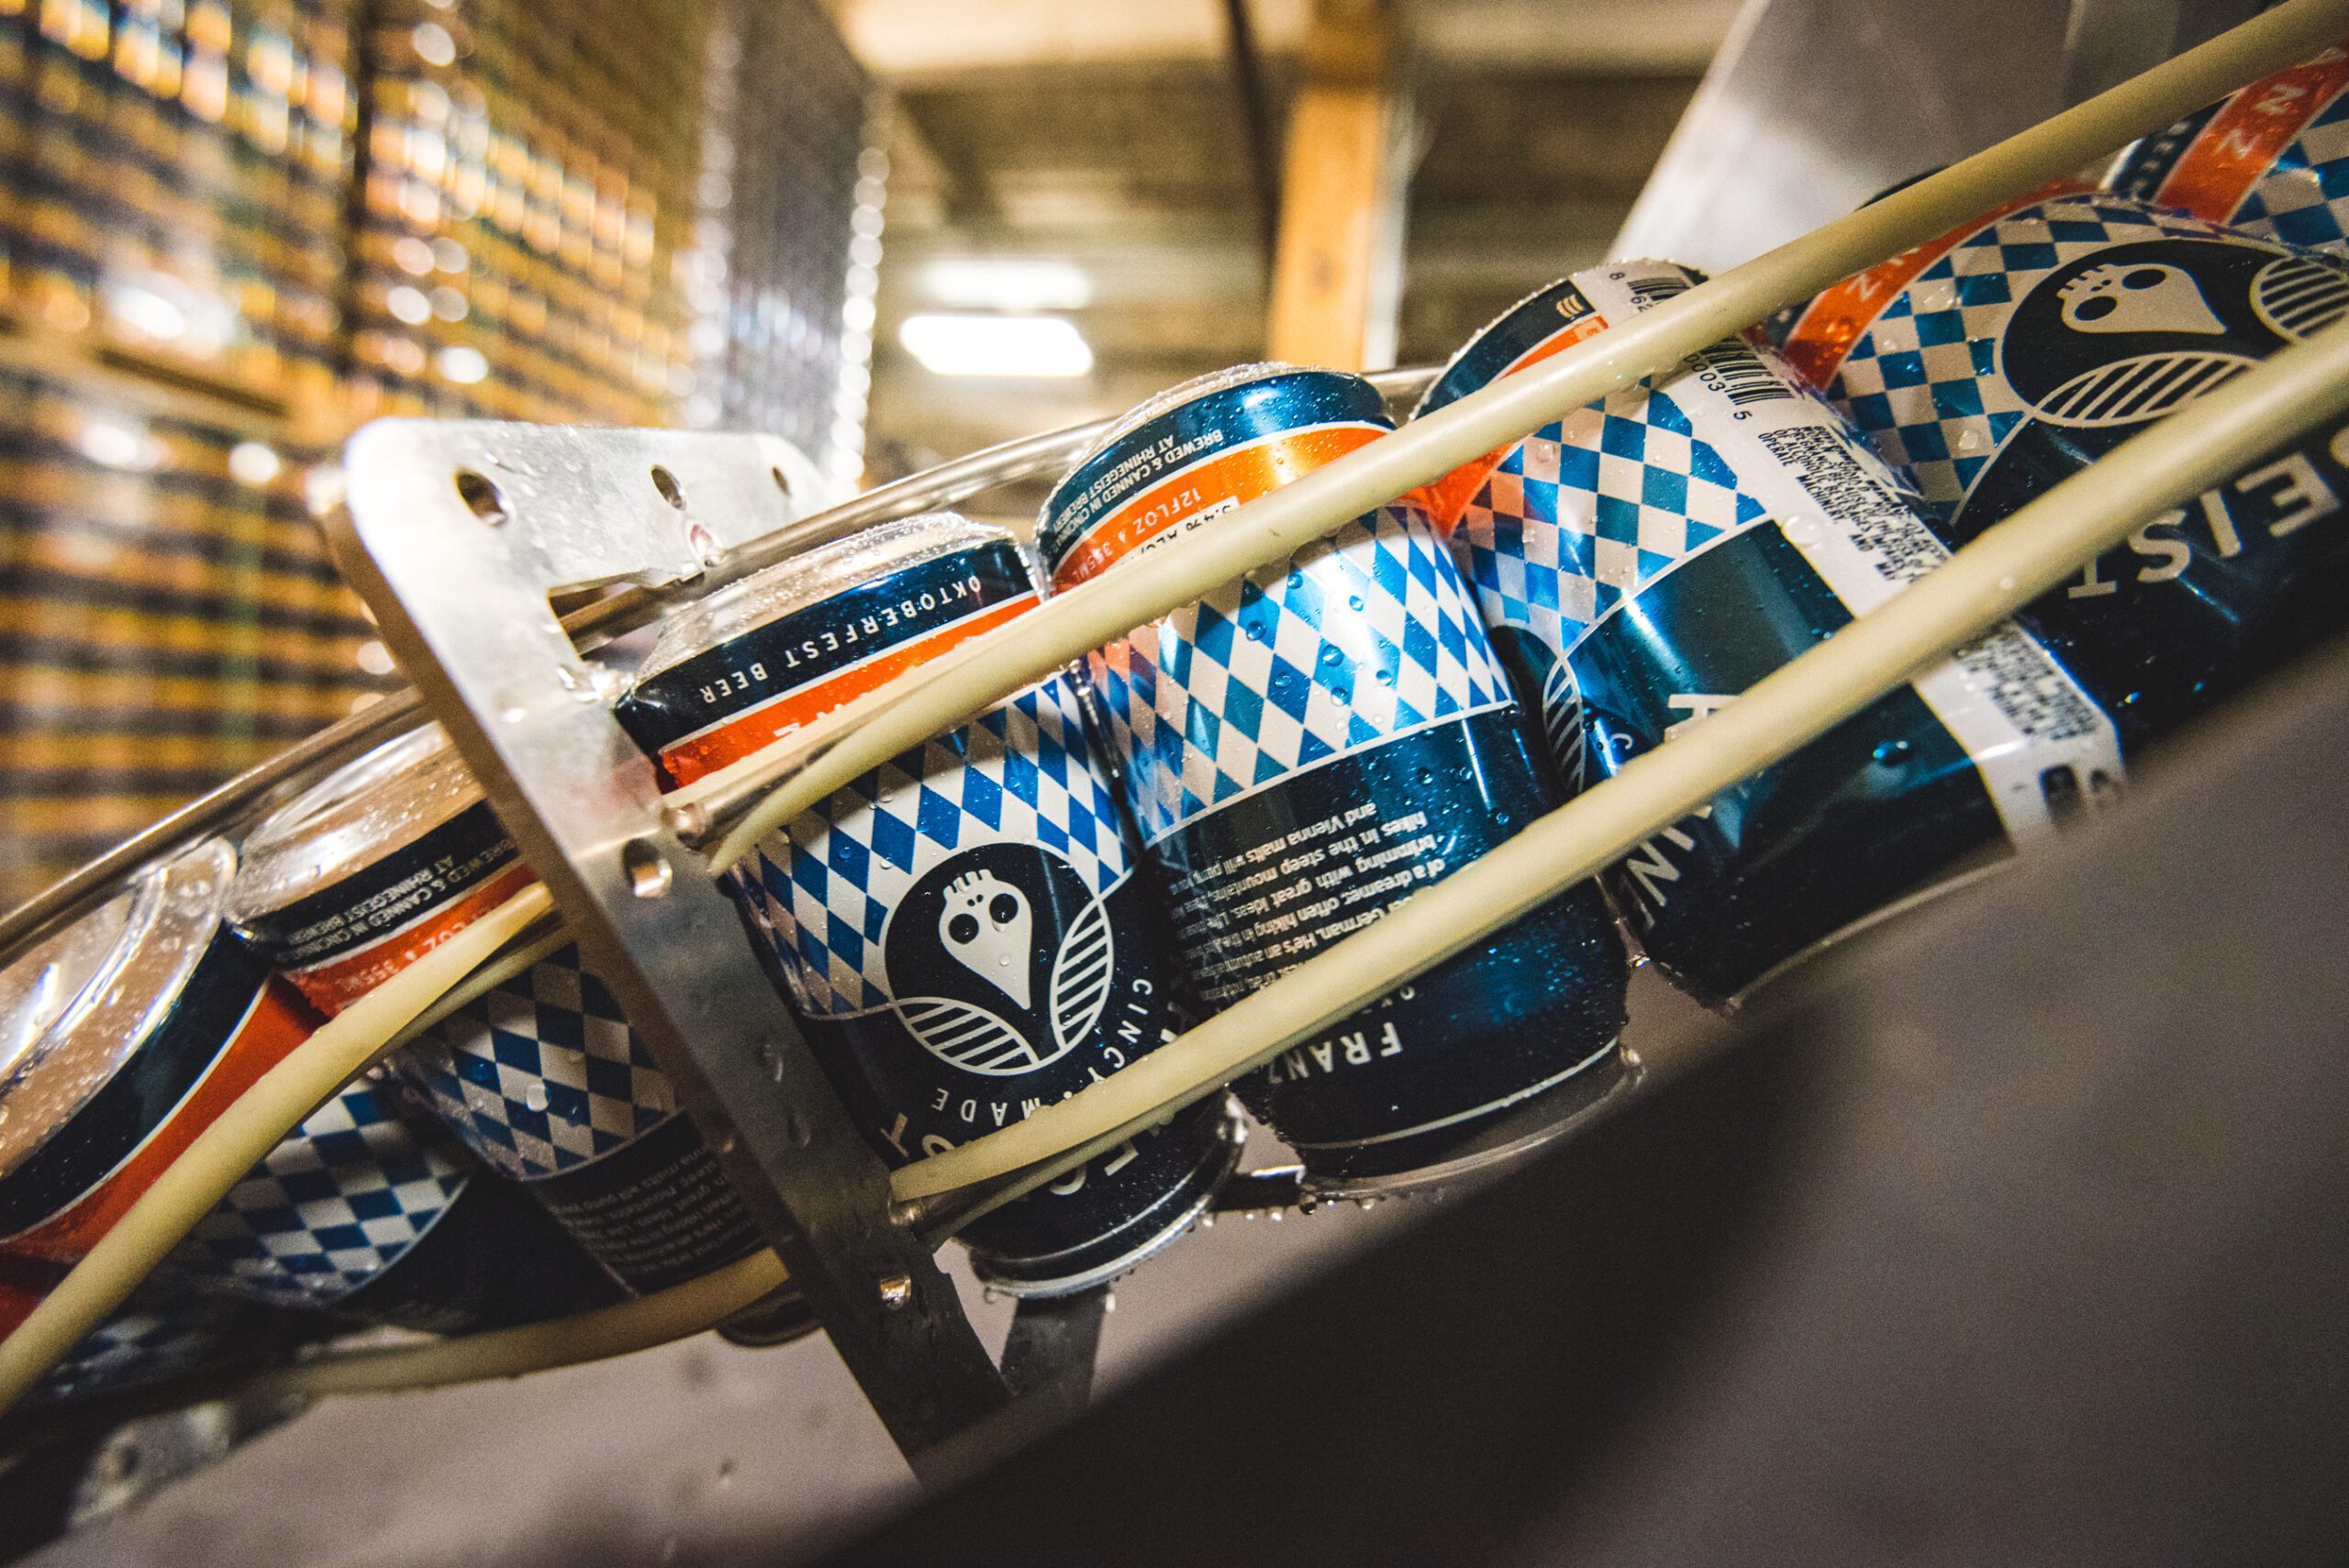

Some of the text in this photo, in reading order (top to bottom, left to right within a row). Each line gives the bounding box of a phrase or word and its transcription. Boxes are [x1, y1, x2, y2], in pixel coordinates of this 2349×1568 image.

[1607, 271, 1627, 281] 8
[1731, 409, 1753, 421] 5
[1155, 433, 1174, 453] AT
[1162, 428, 1223, 464] BREWED
[1756, 432, 1798, 466] OPERATE
[1086, 444, 1156, 496] RHINEGEIST
[1151, 456, 1163, 471] &
[1099, 462, 1152, 502] CANNED
[1087, 497, 1103, 513] IN
[700, 575, 982, 705] OKTOBERFEST BEER
[1342, 802, 1378, 827] and
[1379, 810, 1427, 837] hikes
[1286, 814, 1345, 845] Vienna
[1358, 828, 1380, 845] in
[1243, 837, 1287, 862] malts
[1326, 836, 1358, 856] the
[1354, 833, 1436, 874] brimming
[432, 853, 454, 874] AT
[1278, 848, 1326, 875] steep
[1411, 863, 1426, 880] a
[1424, 857, 1445, 877] of
[1315, 864, 1353, 891] with
[341, 866, 433, 923] RHINEGEIST
[1269, 876, 1313, 909] great
[365, 884, 434, 929] CANNED
[1297, 895, 1341, 922] often
[1252, 911, 1297, 938] hiking
[1281, 932, 1317, 954] He's
